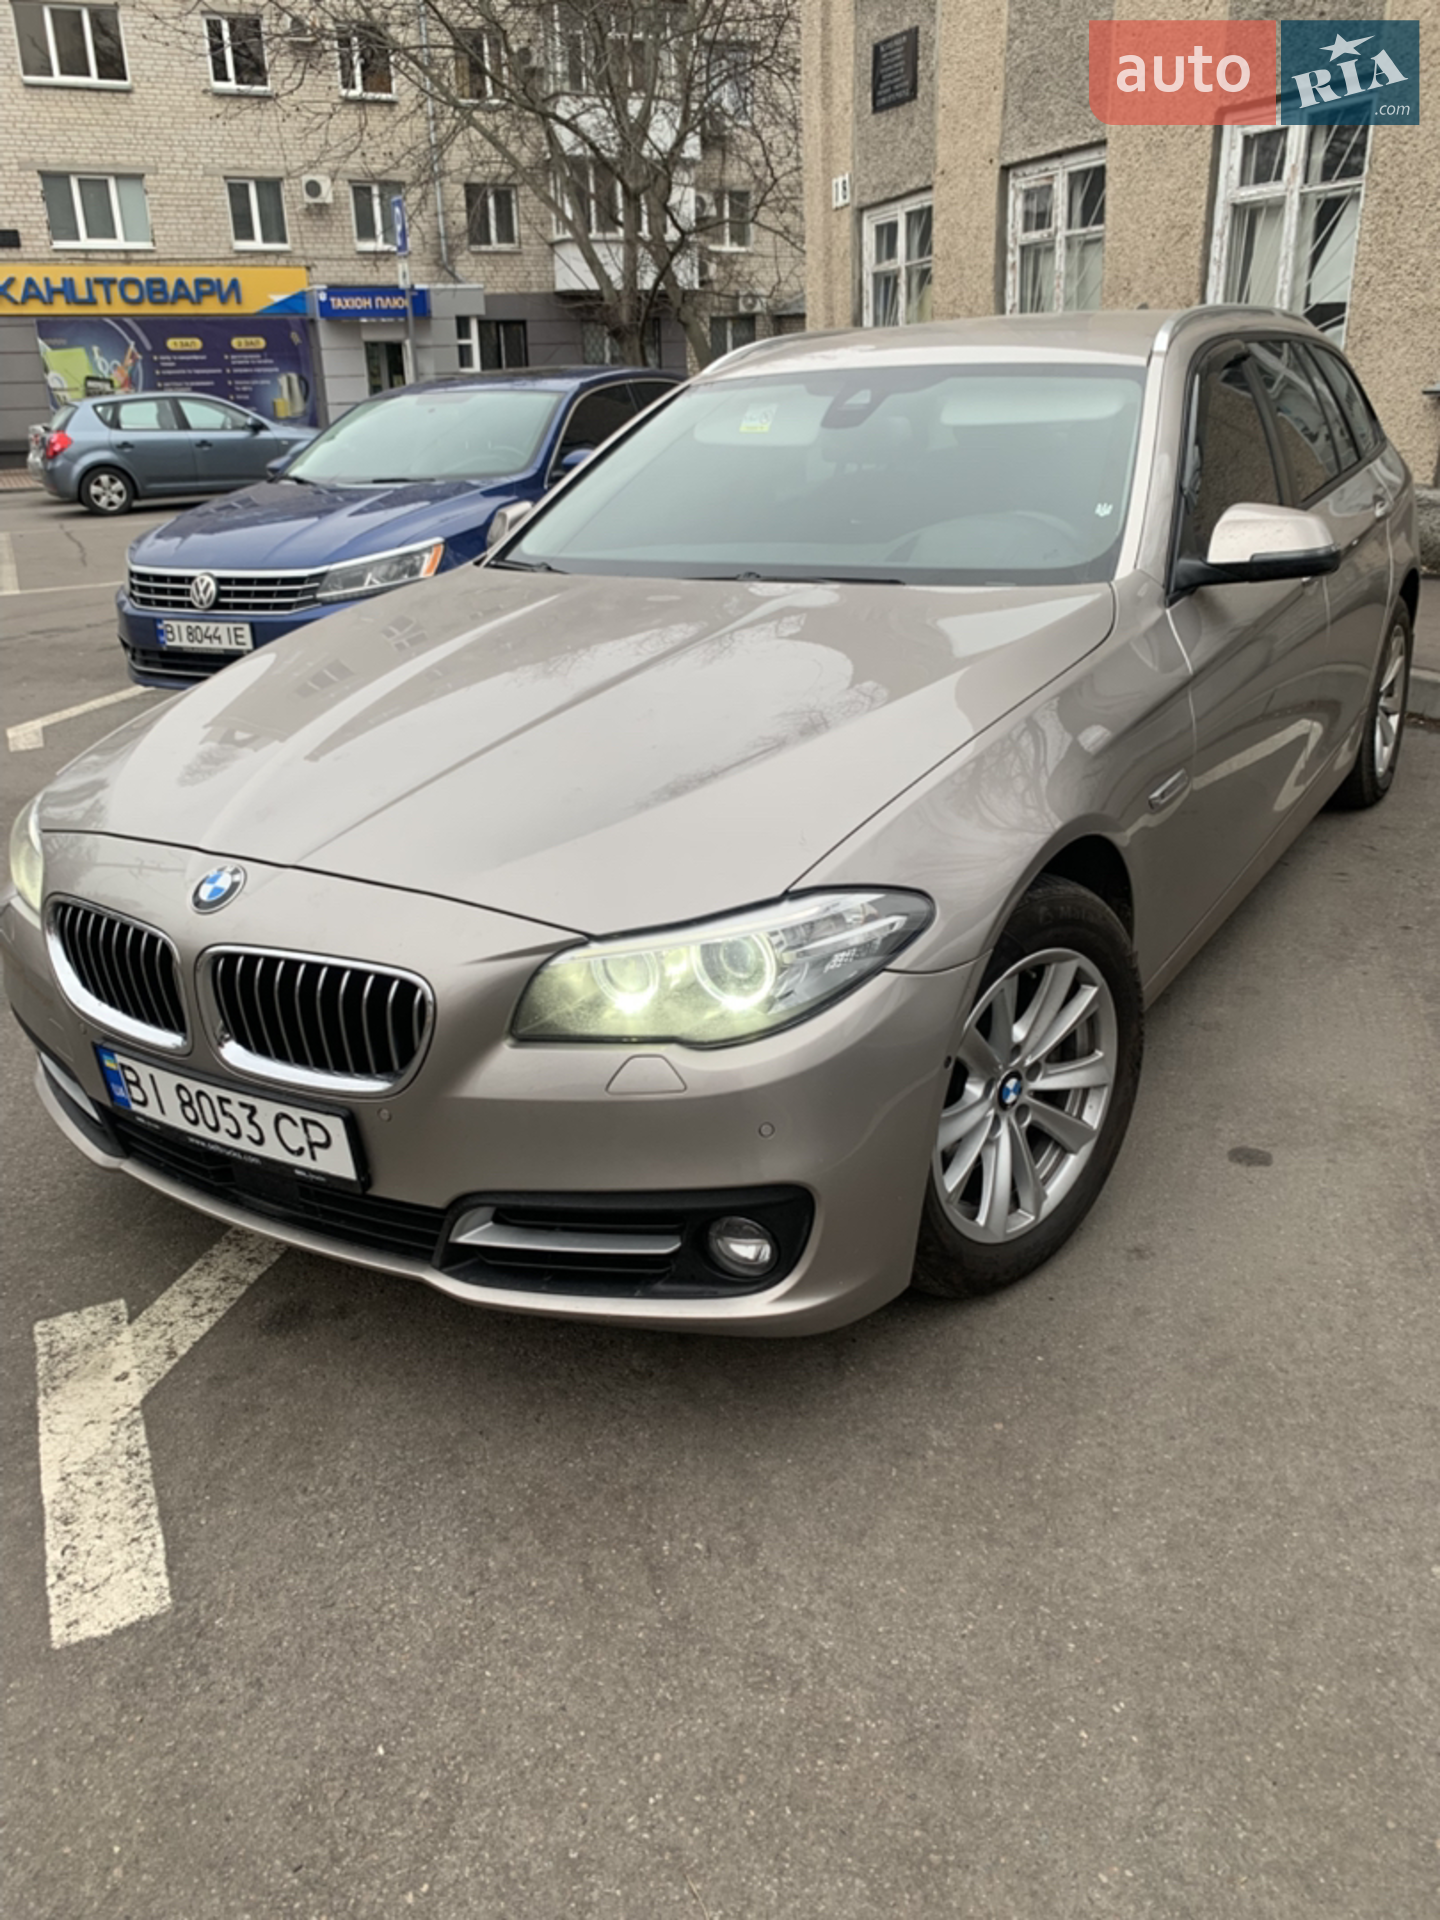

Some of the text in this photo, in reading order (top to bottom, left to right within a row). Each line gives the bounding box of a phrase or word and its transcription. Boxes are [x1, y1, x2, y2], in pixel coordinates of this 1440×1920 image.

[165, 623, 247, 646] BI 8044 IE
[119, 1062, 167, 1116] BI
[175, 1083, 266, 1147] 8053
[273, 1112, 332, 1161] CP
